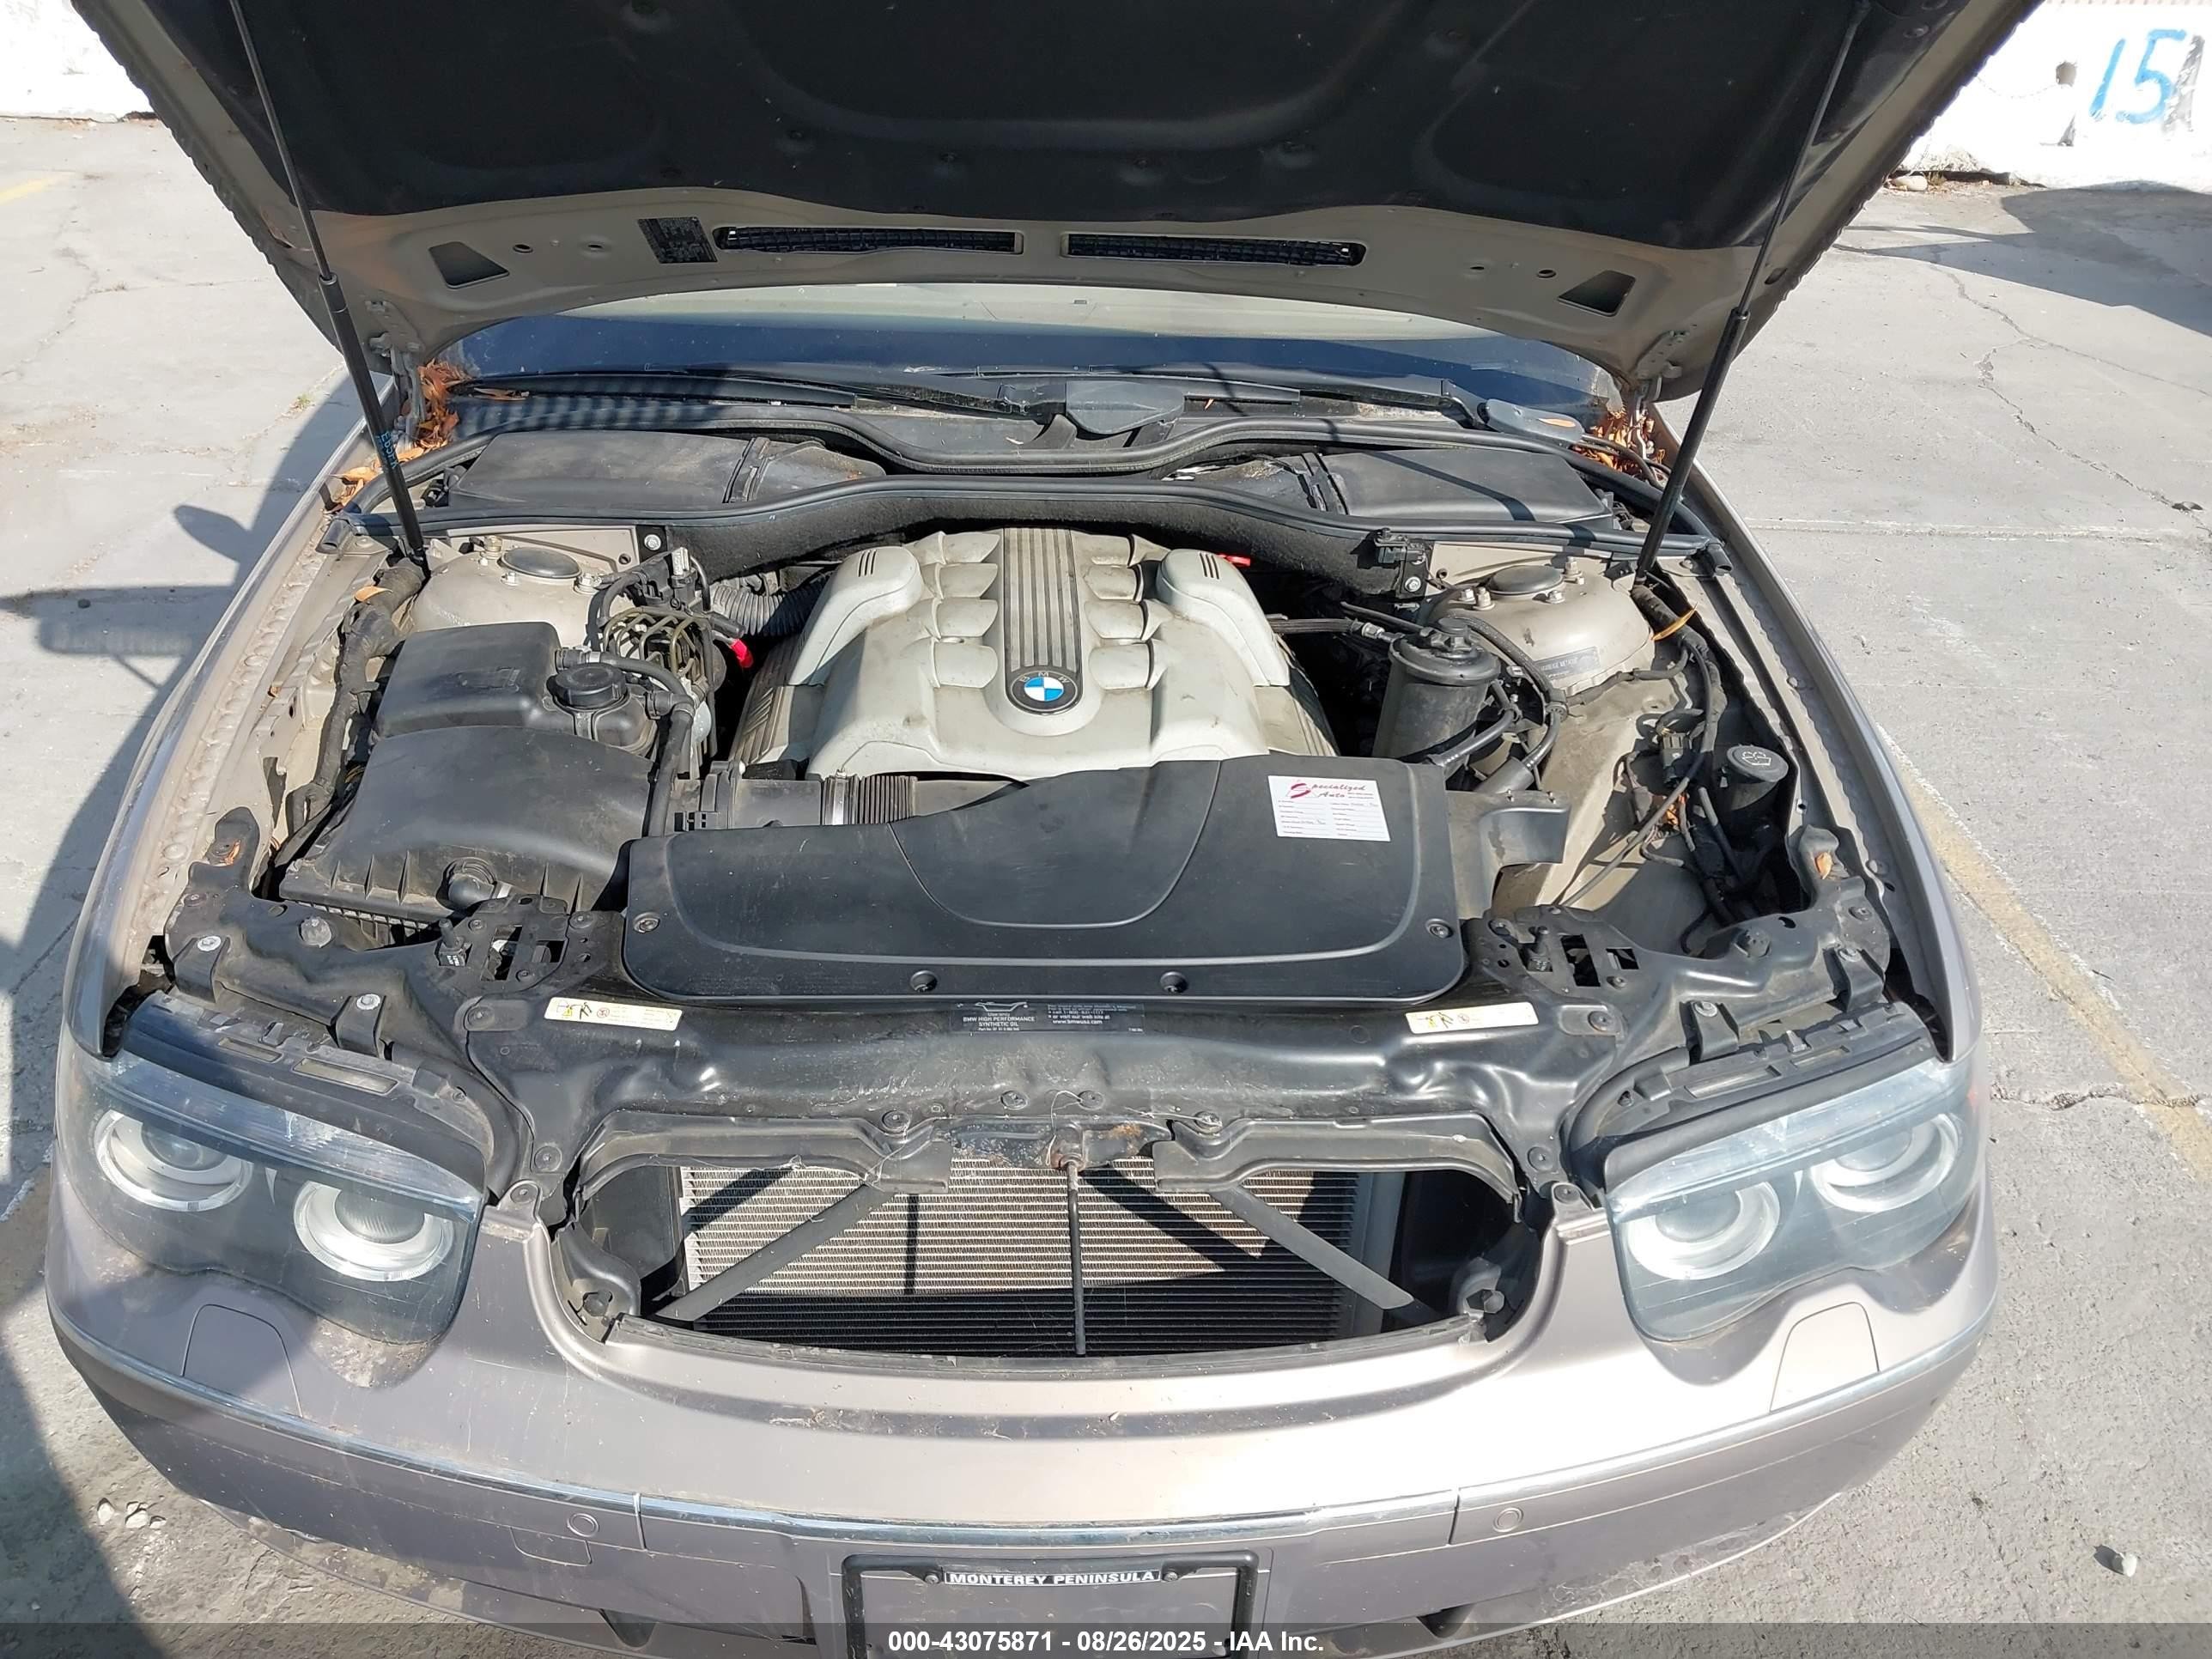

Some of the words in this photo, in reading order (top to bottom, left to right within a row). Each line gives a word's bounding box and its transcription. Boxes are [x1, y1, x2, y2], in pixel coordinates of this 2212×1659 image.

[2088, 29, 2187, 125] 15
[1018, 672, 1071, 684] BMW
[1290, 782, 1366, 799] Specialized
[950, 1572, 1048, 1585] MONTEREY
[1054, 1571, 1155, 1584] PENINSULA
